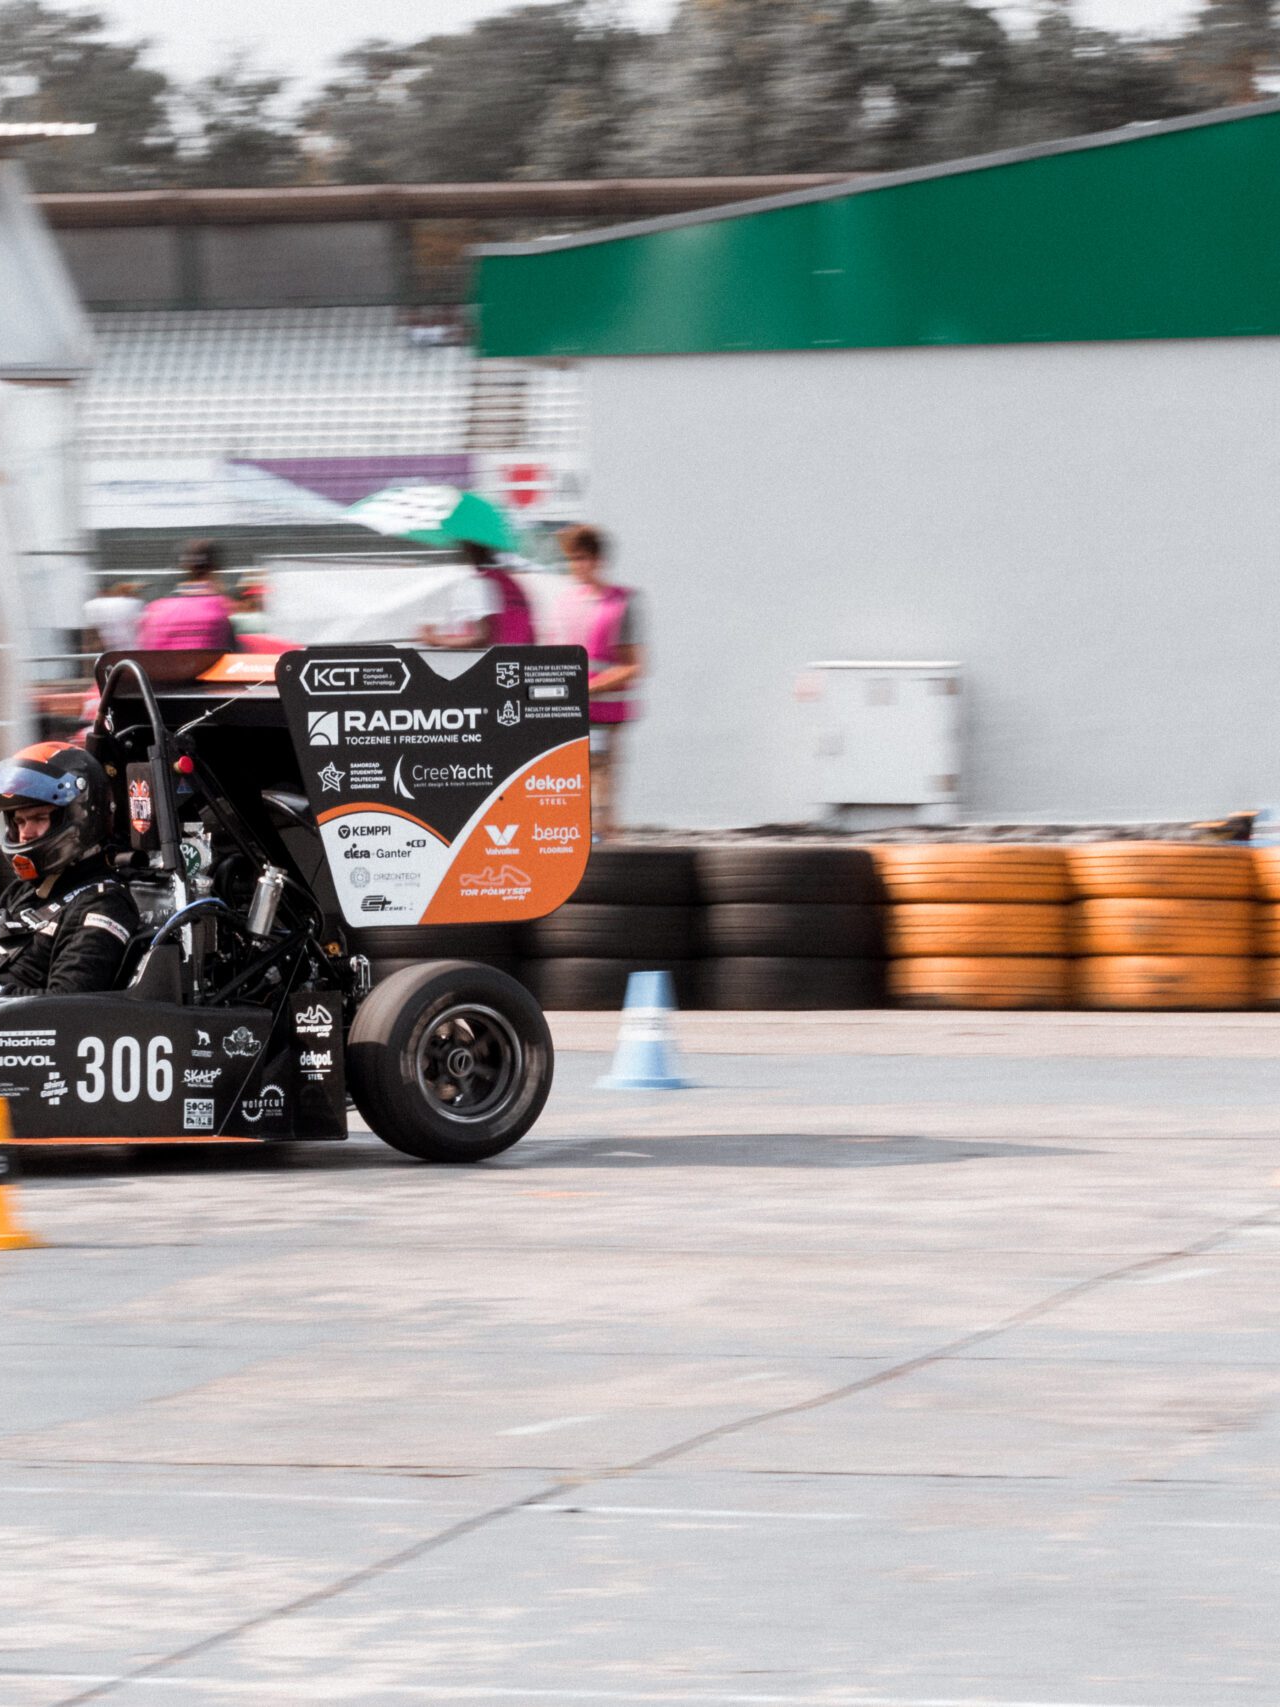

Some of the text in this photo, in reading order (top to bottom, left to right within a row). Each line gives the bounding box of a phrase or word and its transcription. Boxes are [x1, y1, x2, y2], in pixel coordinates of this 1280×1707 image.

[314, 667, 360, 687] KCT
[344, 708, 482, 732] RADMOT
[345, 736, 391, 745] TOCZENIE
[399, 734, 459, 744] FREZOWANIE
[461, 734, 482, 743] CNC
[412, 763, 493, 781] CreeYacht
[525, 774, 581, 792] dekpol
[352, 826, 391, 836] KEMPPI
[376, 848, 412, 858] Ganter
[485, 847, 520, 855] Valvoline
[539, 846, 574, 854] FLOORING
[460, 889, 479, 897] TOR
[300, 1050, 332, 1069] dekpol
[76, 1035, 174, 1103] 306
[186, 1102, 213, 1111] SOCHA
